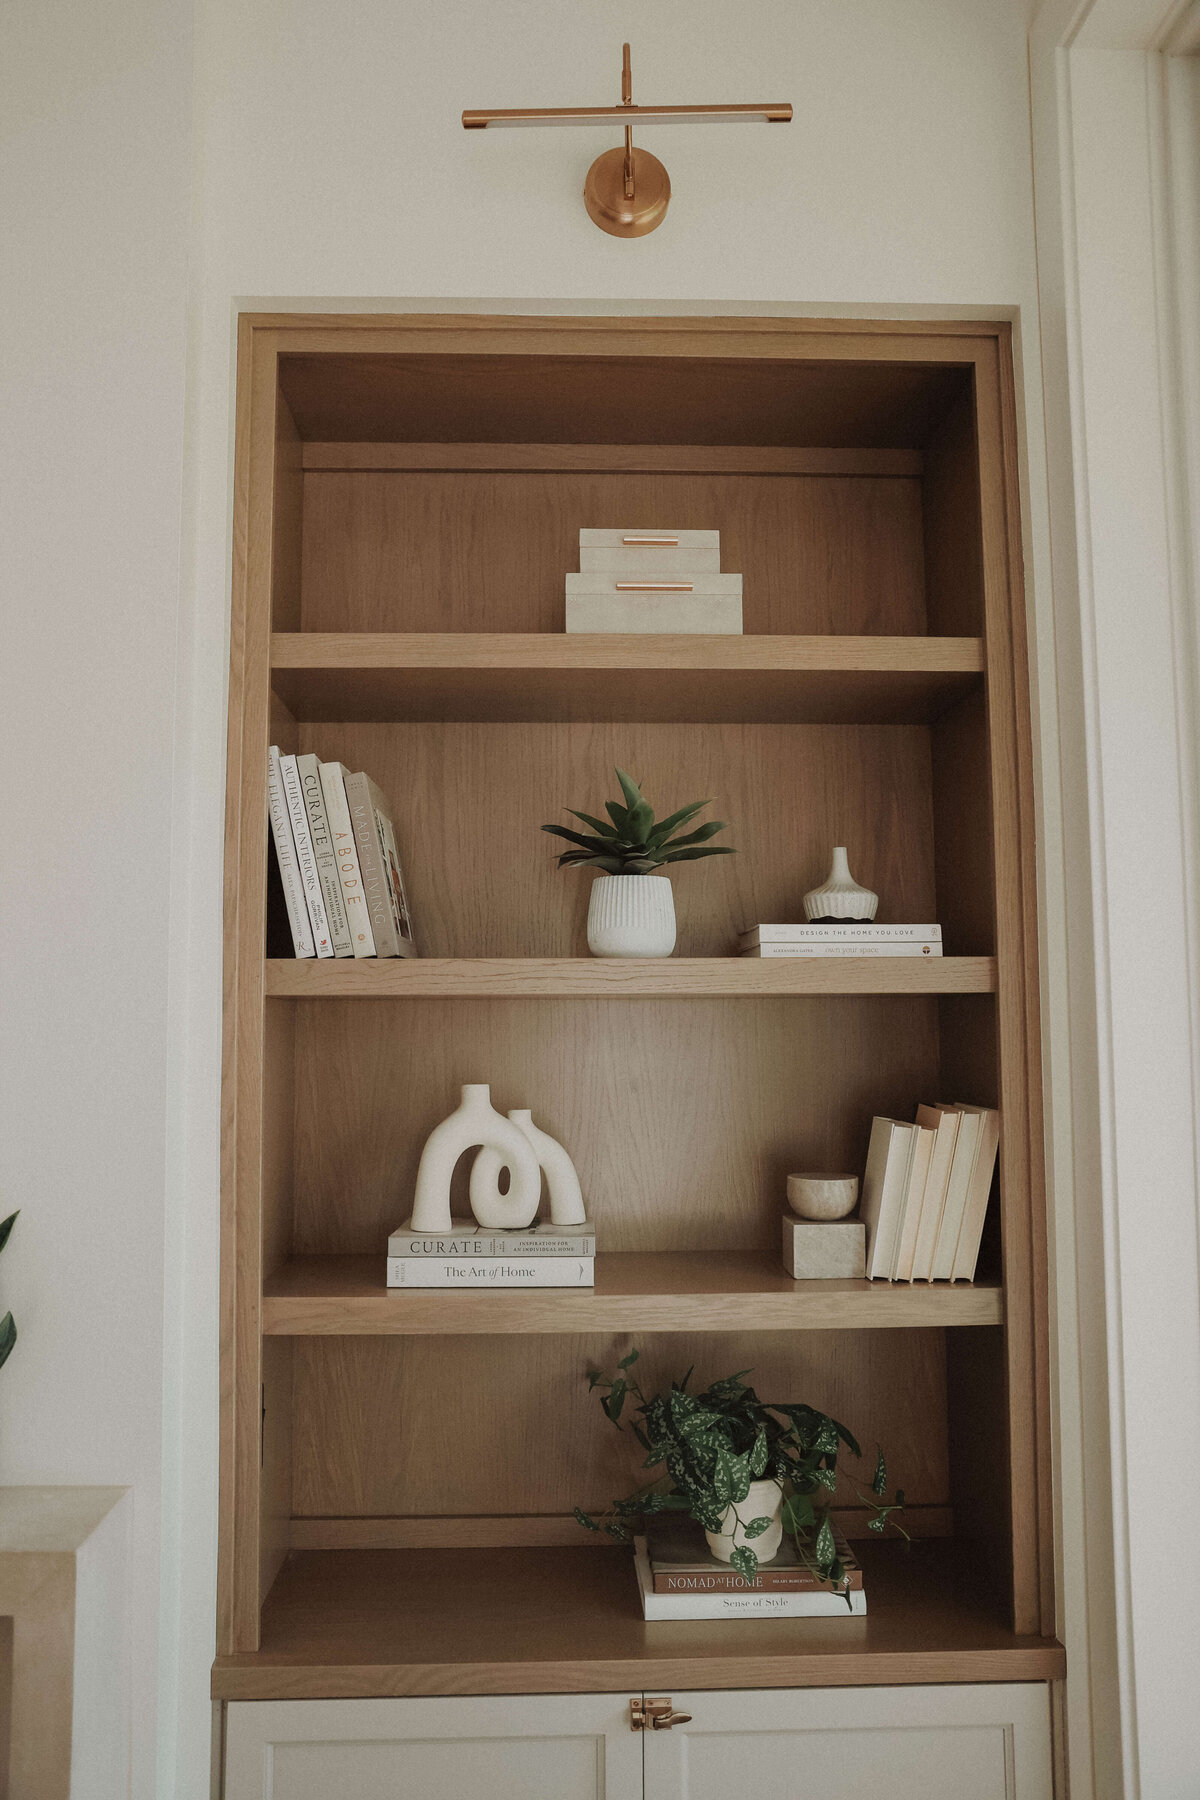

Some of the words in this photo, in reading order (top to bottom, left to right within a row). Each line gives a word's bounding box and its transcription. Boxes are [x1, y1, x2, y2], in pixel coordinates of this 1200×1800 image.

[269, 785, 287, 839] ELEGANT
[280, 843, 292, 869] LIFE
[285, 765, 305, 830] AUTHENTIC
[297, 831, 316, 891] INTERIORS
[304, 775, 328, 846] CURATE
[335, 832, 361, 905] ABODE
[352, 805, 371, 851] MADE
[366, 866, 386, 925] LIVING
[310, 899, 321, 931] GORRIVAN
[316, 904, 324, 924] PHILIP
[325, 885, 337, 918] INDIVIDUAL
[332, 919, 340, 936] HOME
[330, 880, 342, 916] INSPIRATION
[410, 1241, 482, 1253] CURATE
[443, 1266, 466, 1278] The
[468, 1266, 486, 1278] Art
[489, 1266, 499, 1280] of
[501, 1266, 536, 1278] Home
[668, 1577, 715, 1589] NOMAD
[726, 1576, 764, 1588] HOME
[722, 1599, 750, 1608] Sense
[752, 1599, 763, 1607] of
[765, 1598, 789, 1609] Style
